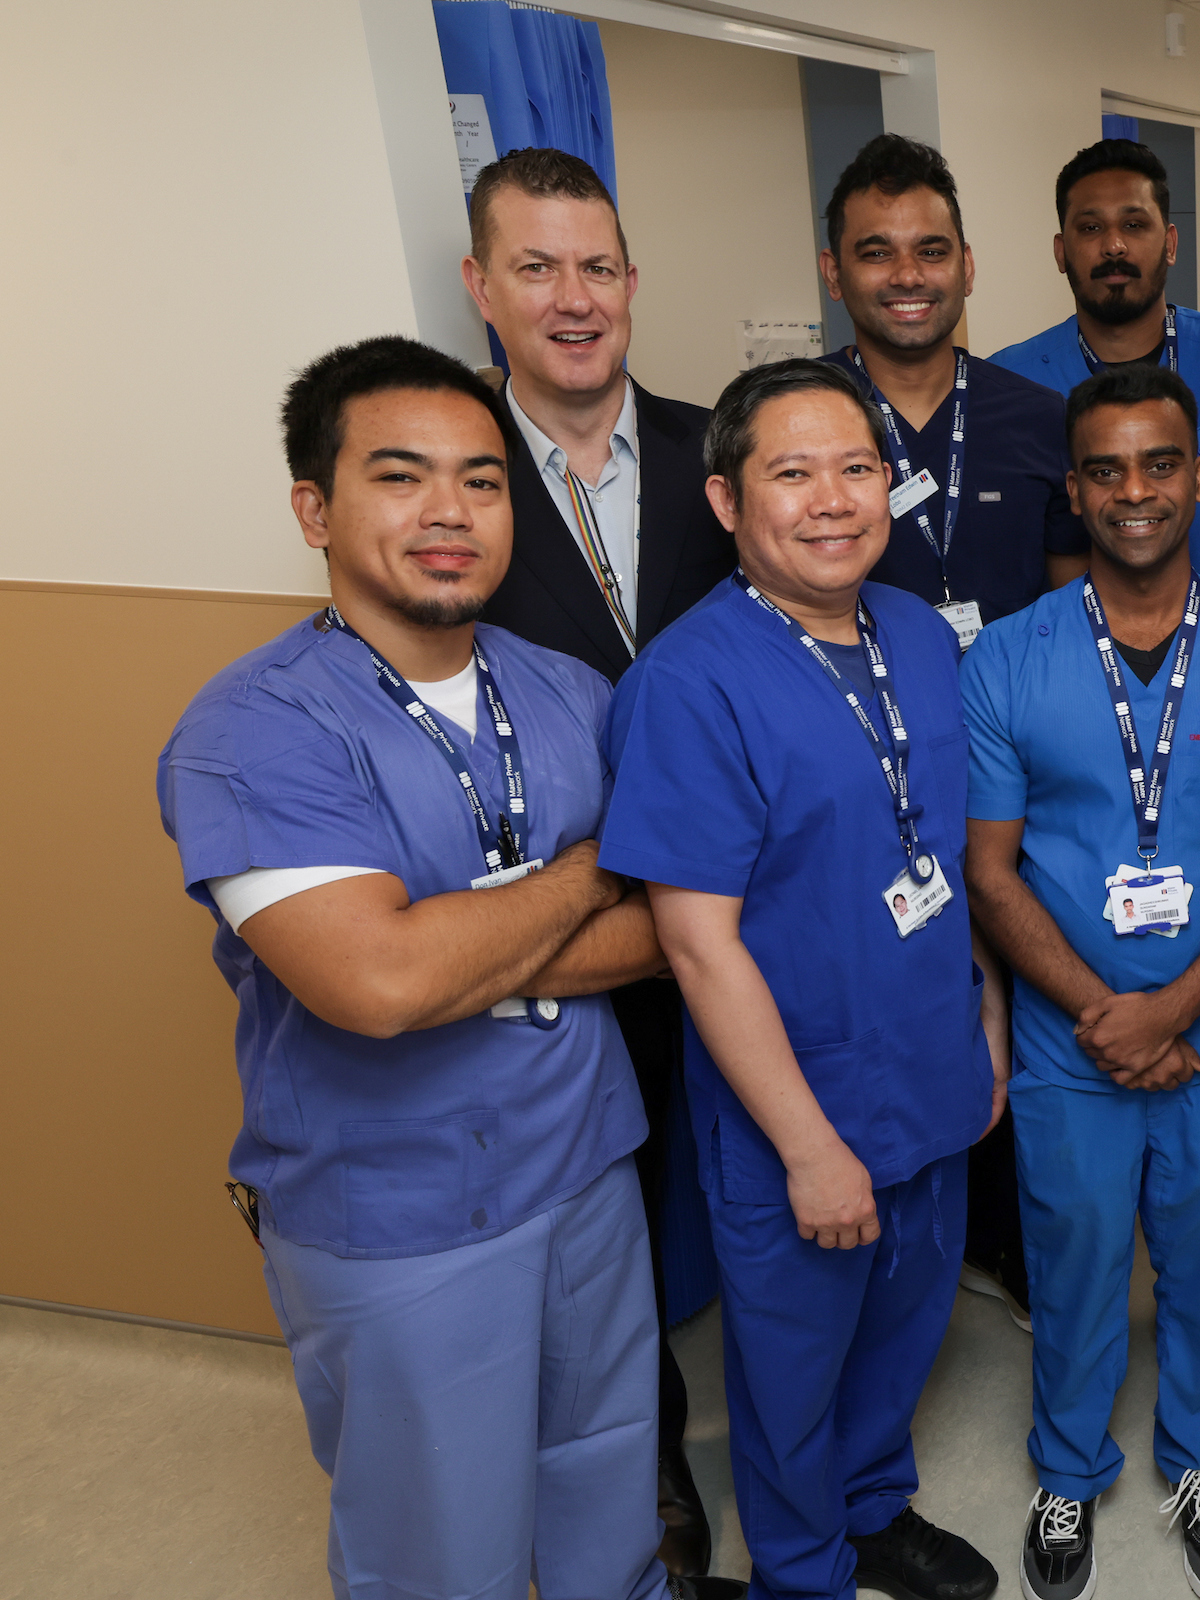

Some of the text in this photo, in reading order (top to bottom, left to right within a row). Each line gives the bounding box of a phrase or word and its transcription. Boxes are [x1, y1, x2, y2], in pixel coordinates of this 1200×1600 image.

[893, 428, 902, 445] Private
[1093, 606, 1103, 625] Private
[1187, 597, 1195, 613] Mater
[810, 647, 827, 667] Network
[814, 645, 841, 679] Mater Private
[1101, 652, 1111, 673] Network
[1174, 638, 1187, 673] Mater Private
[1180, 654, 1189, 675] Network
[382, 666, 401, 688] Private
[1107, 650, 1121, 687] Mater Private
[417, 718, 437, 739] Network
[854, 707, 867, 729] Network
[857, 705, 879, 742] Mater Private
[1120, 717, 1128, 738] Network
[1160, 702, 1173, 739] Mater Private
[423, 714, 454, 754] Mater Private
[1125, 715, 1137, 753] Mater Private
[1166, 719, 1175, 740] Network
[505, 753, 513, 776] Private
[1147, 768, 1159, 807] Mater Private
[1153, 786, 1162, 808] Network
[466, 788, 477, 815] Network
[470, 787, 489, 832] Mater Private
